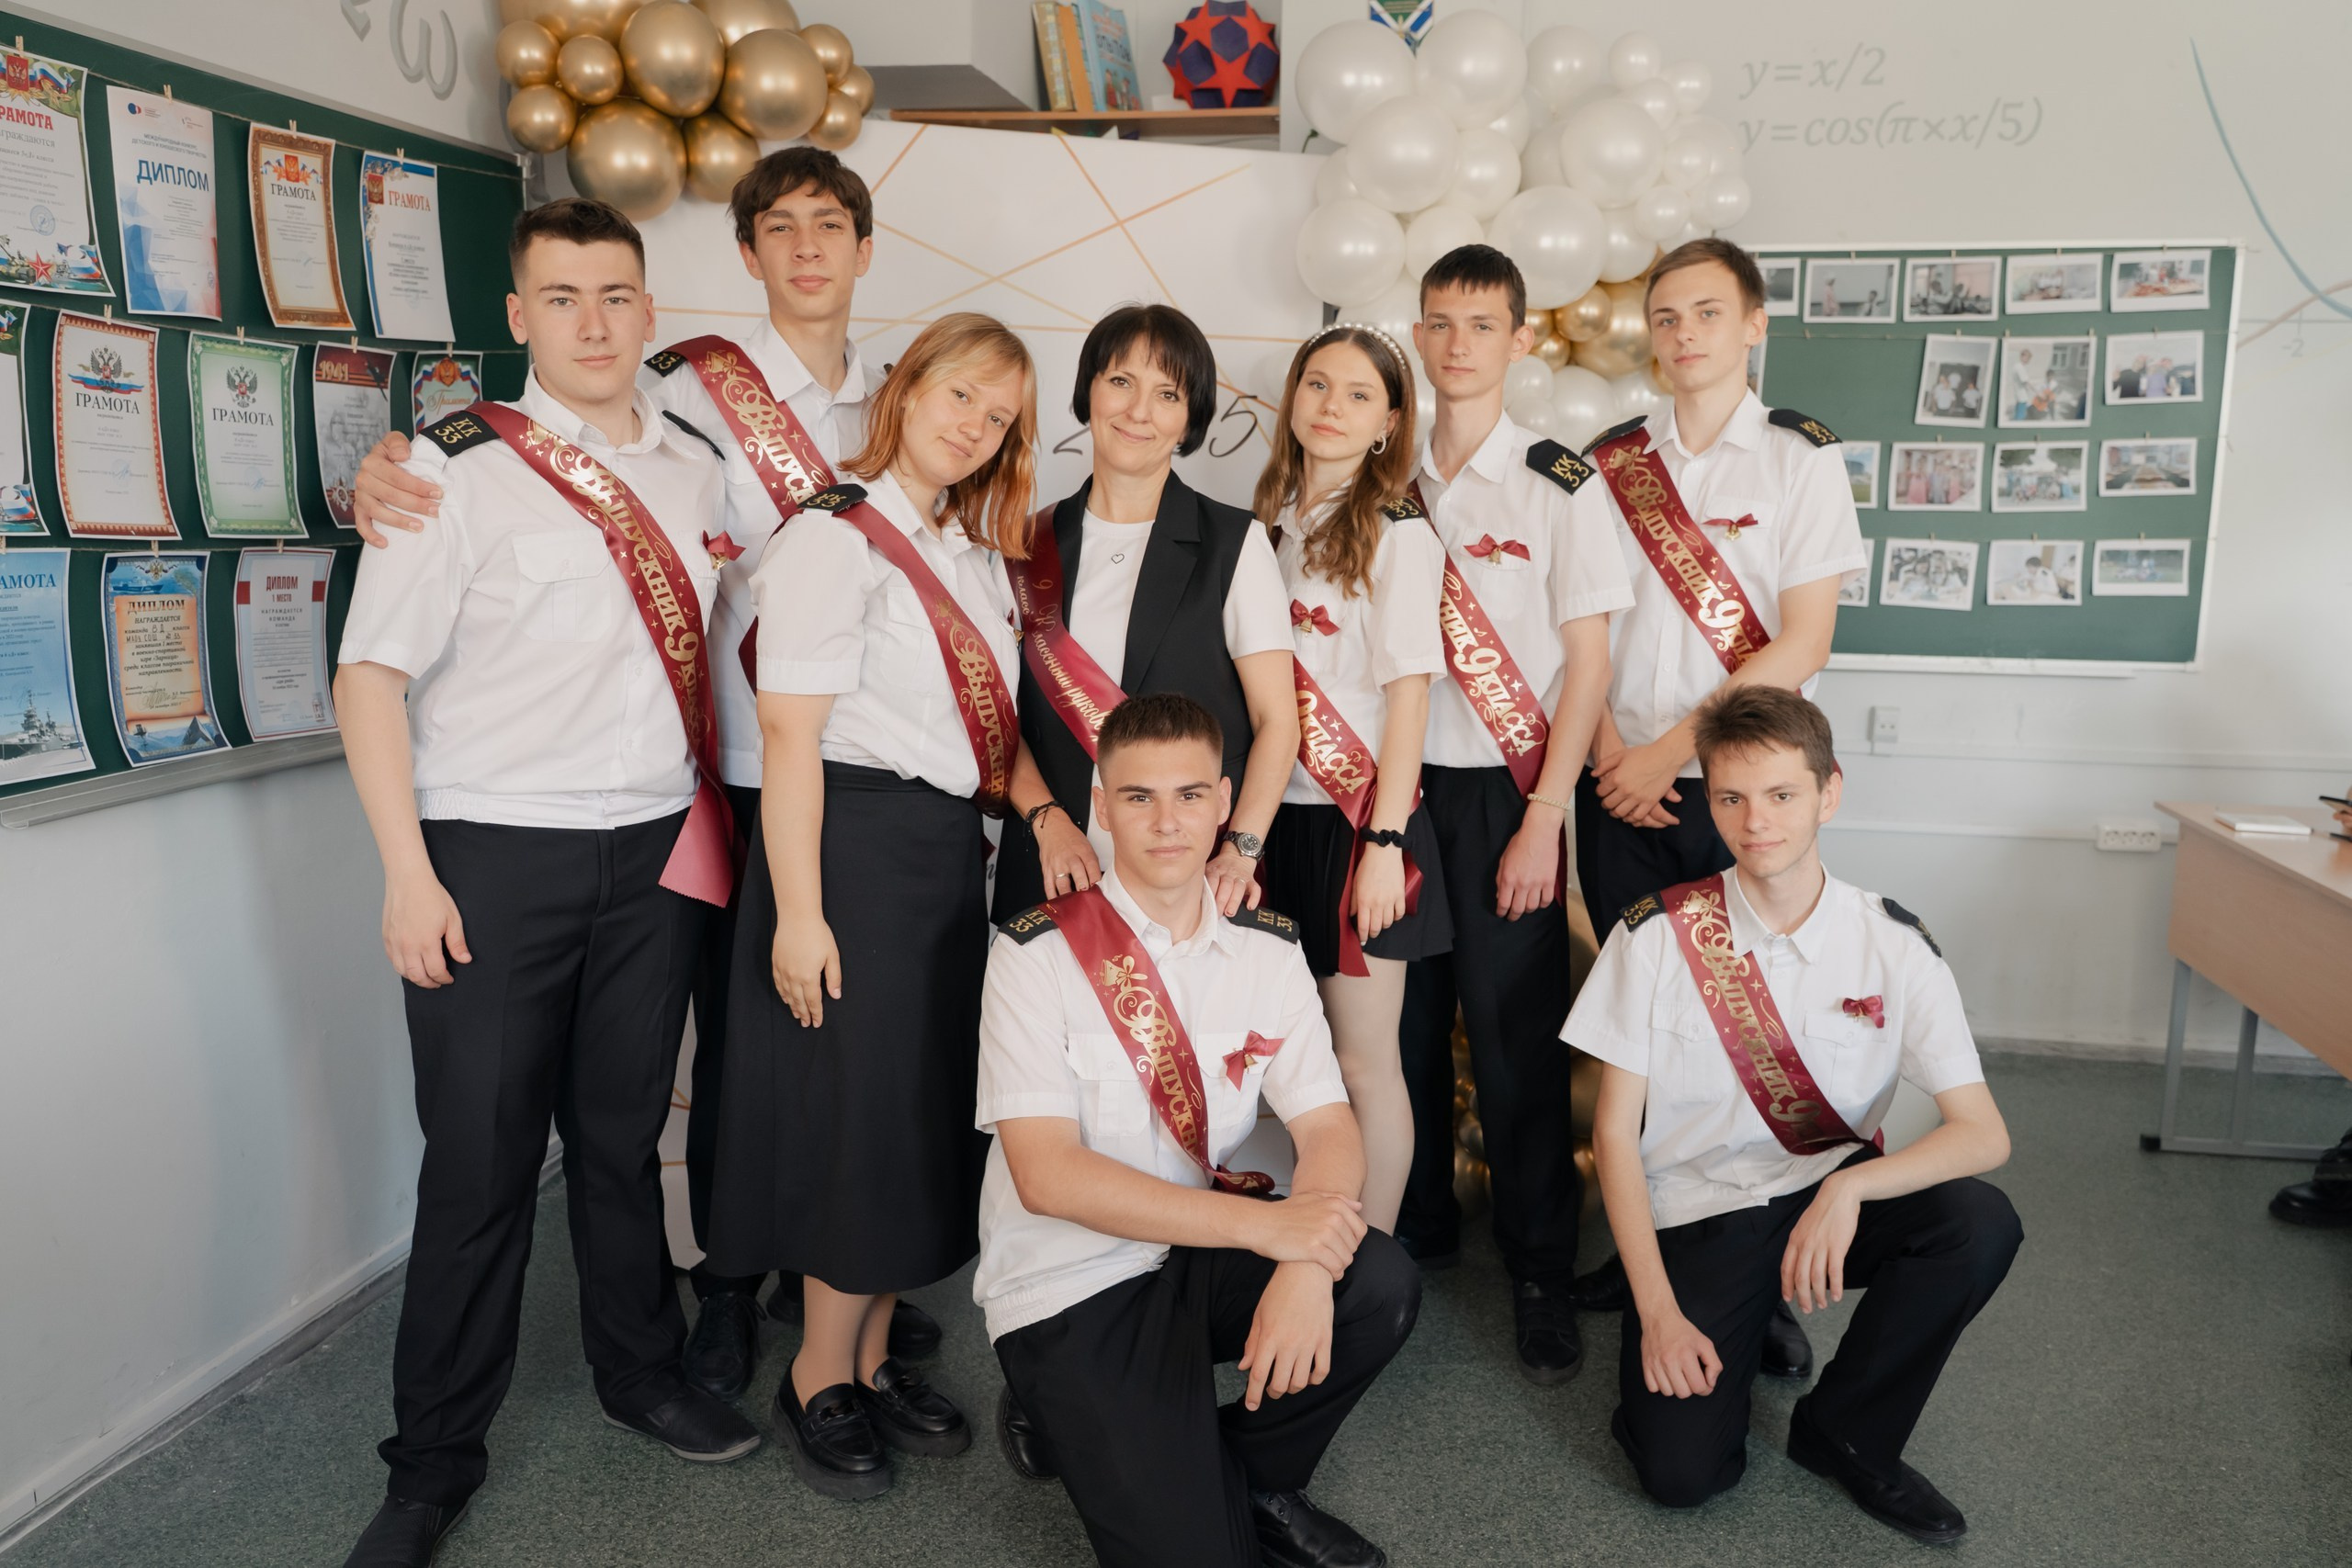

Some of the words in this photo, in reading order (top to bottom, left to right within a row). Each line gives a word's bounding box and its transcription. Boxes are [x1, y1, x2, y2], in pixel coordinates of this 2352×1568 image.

[0, 106, 54, 130] РАМОТА
[0, 129, 56, 149] граждаются
[137, 159, 209, 192] ДИПЛОМ
[270, 183, 317, 201] ГРАМОТА
[388, 190, 431, 212] ГРАМОТА
[75, 392, 141, 414] ГРАМОТА
[212, 407, 275, 426] ГРАМОТА
[435, 424, 463, 445] 33
[452, 417, 482, 437] КК
[1551, 454, 1577, 478] КК
[1564, 463, 1590, 489] 33
[0, 573, 57, 590] АМОТА
[266, 576, 299, 591] ДИПЛОМ
[1032, 579, 1054, 590] 9
[128, 599, 186, 615] ДИПЛОМ
[277, 593, 292, 603] МЕСТО
[135, 615, 181, 624] НАГРАЖДАЕТСЯ
[1698, 599, 1746, 629] 9
[664, 631, 699, 661] 9
[1453, 648, 1502, 685] 9
[1010, 918, 1035, 934] 33
[1025, 909, 1052, 926] КК
[1257, 908, 1275, 925] КК
[1277, 915, 1293, 932] 33
